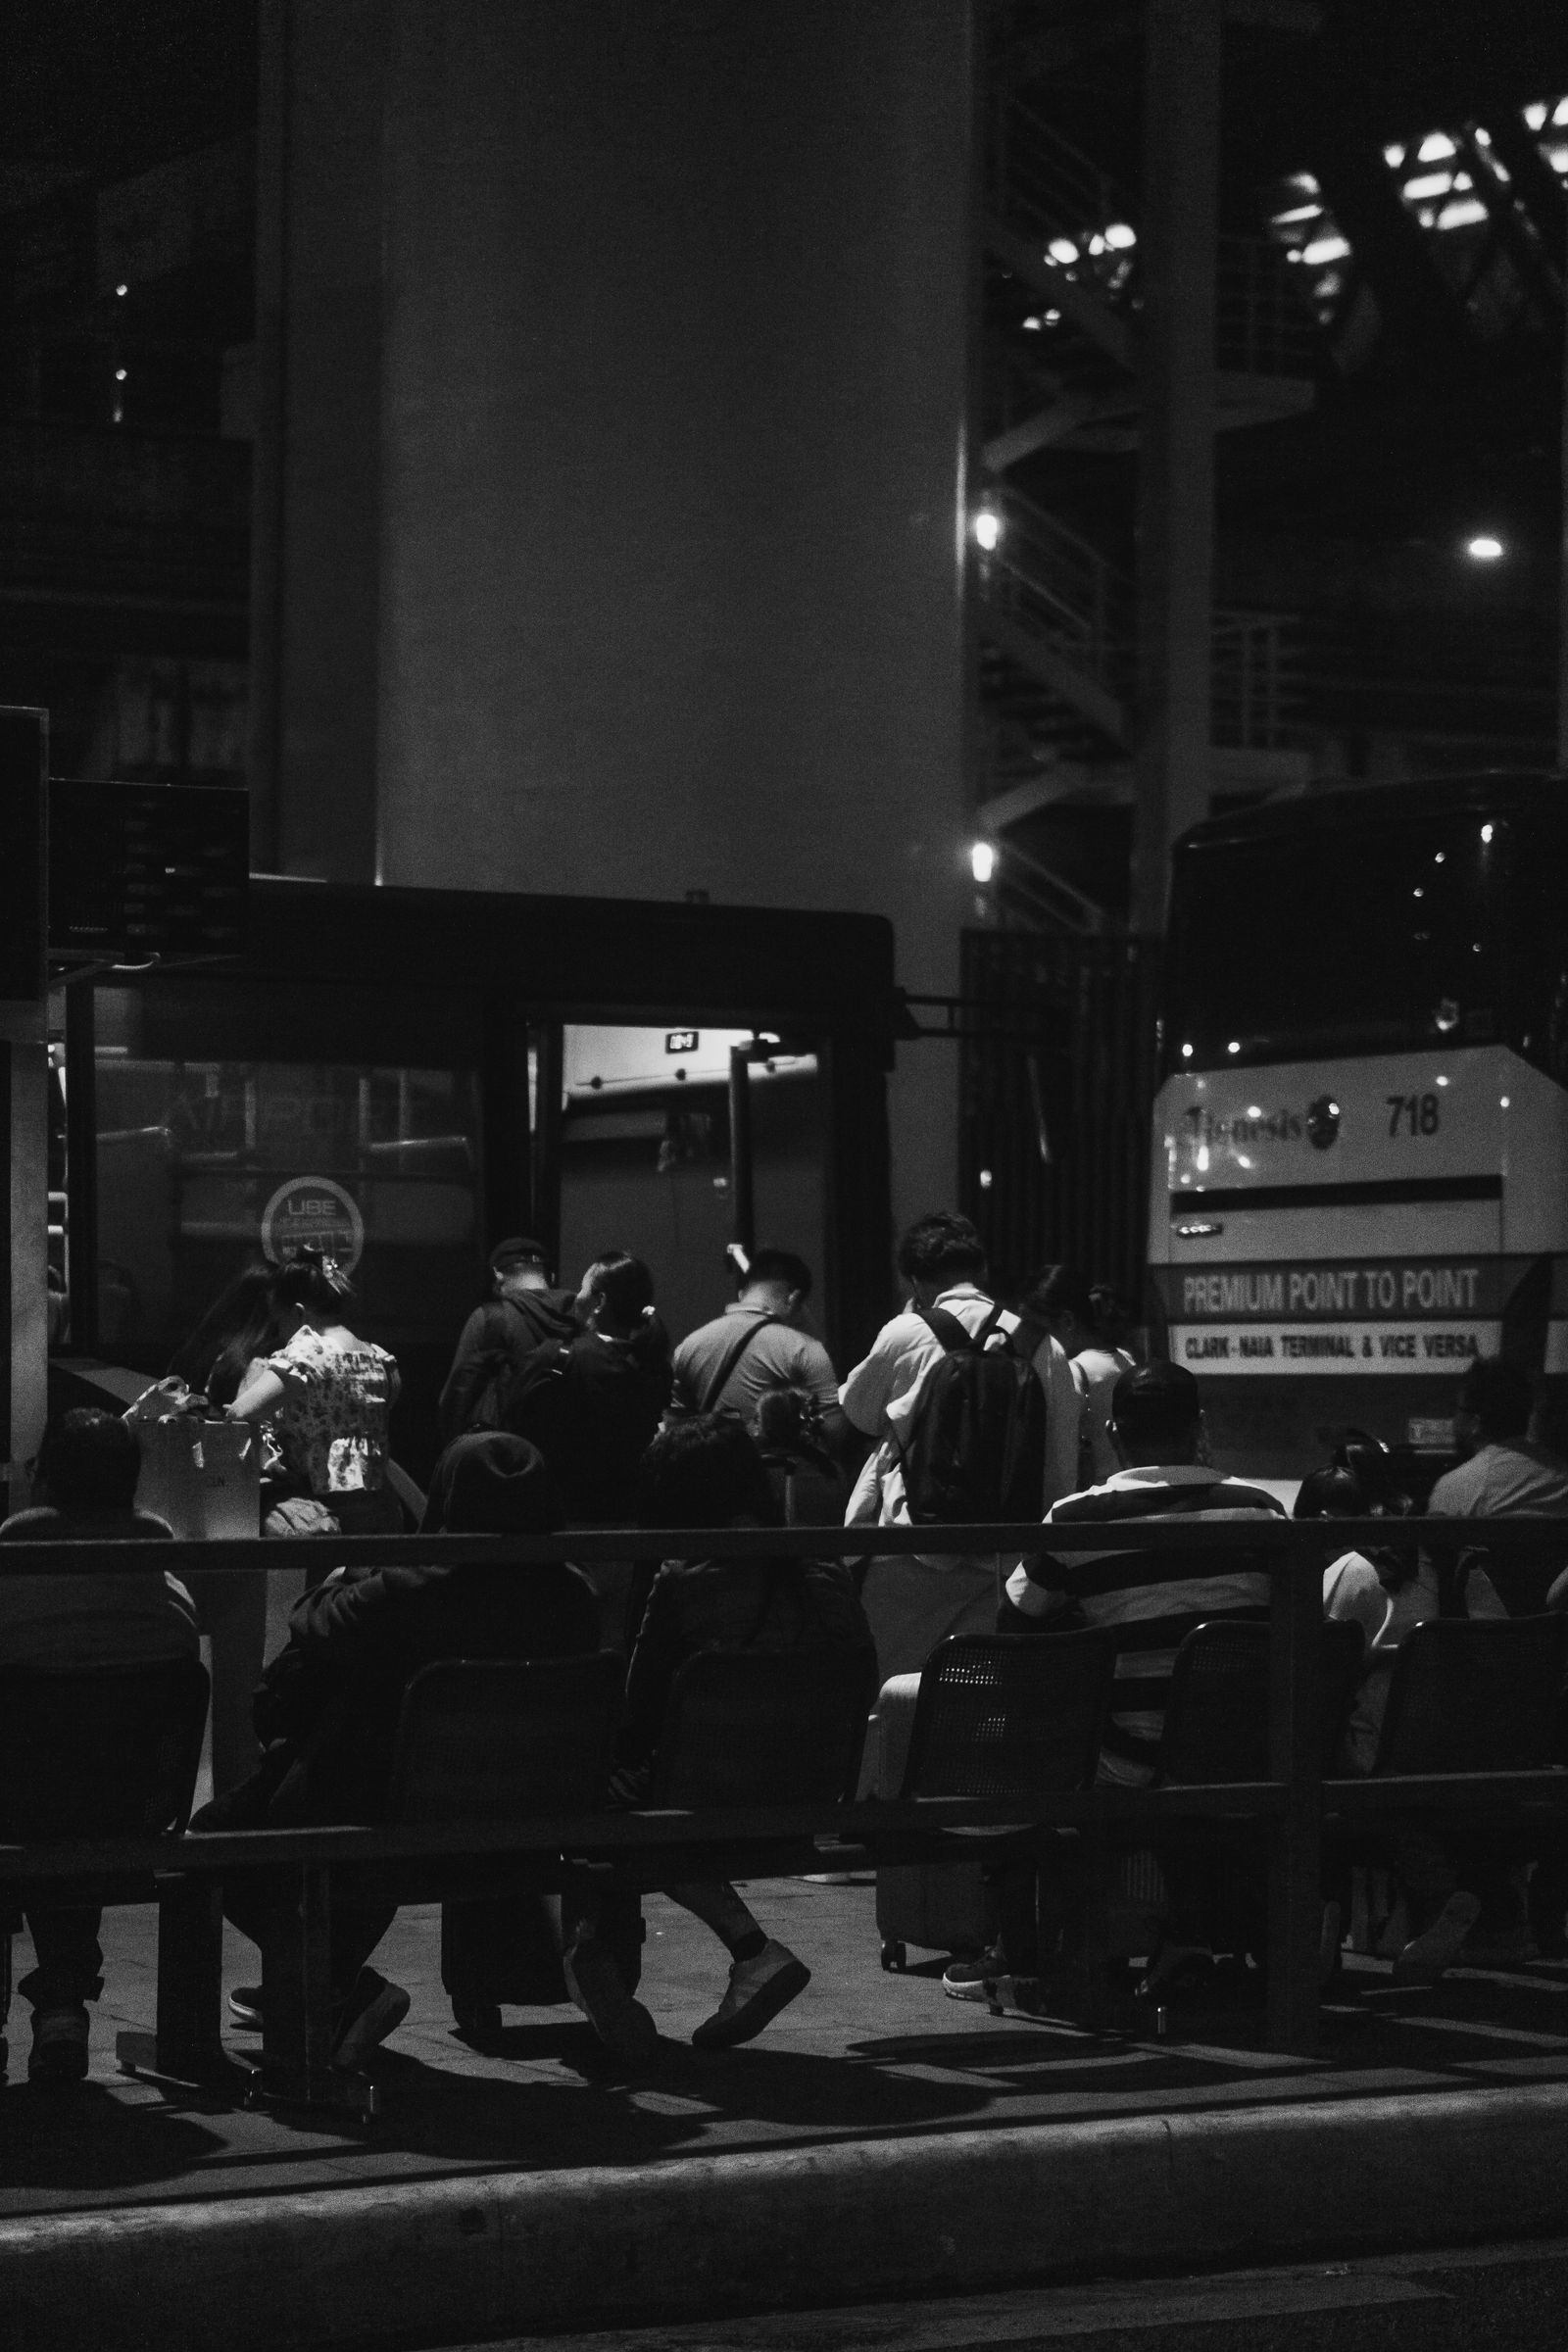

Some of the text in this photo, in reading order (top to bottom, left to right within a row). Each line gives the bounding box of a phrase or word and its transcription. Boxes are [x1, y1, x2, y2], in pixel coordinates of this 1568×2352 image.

[1386, 1092, 1439, 1137] 718
[287, 1199, 336, 1215] UBE
[1184, 1269, 1479, 1312] PREMIUM POINT TO POINT
[1281, 1335, 1354, 1358] TERMINAL
[1363, 1335, 1373, 1358] &
[1379, 1335, 1417, 1357] VICE
[1423, 1335, 1479, 1357] VERSA
